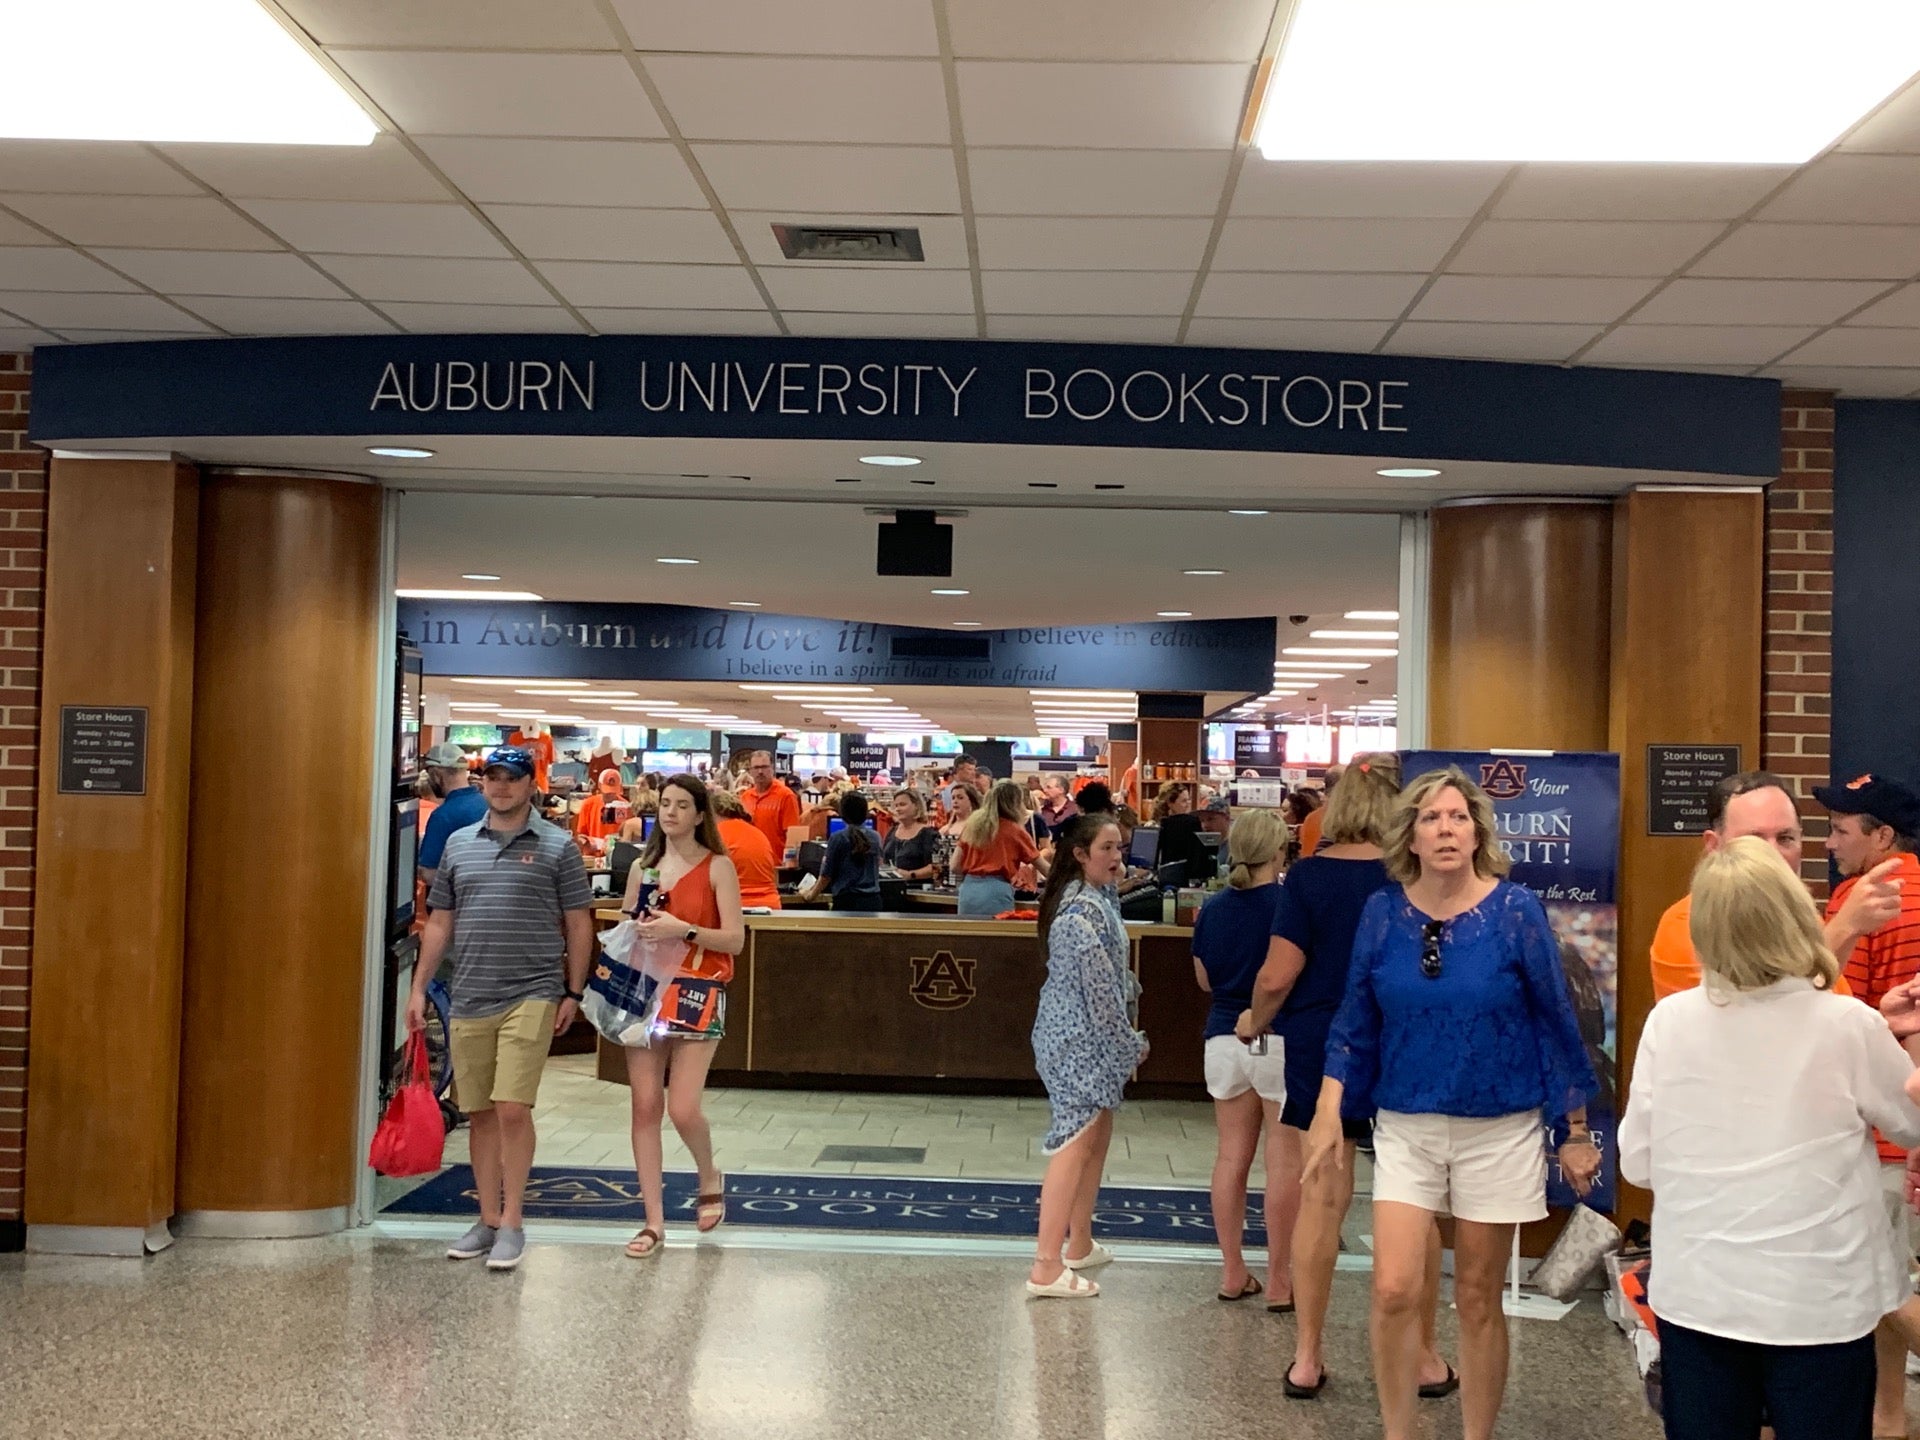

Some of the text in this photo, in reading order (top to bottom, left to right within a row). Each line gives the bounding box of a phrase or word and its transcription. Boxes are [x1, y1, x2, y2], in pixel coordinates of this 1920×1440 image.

[369, 359, 1410, 432] AUBURN UNIVERSITY BOOKSTORE
[420, 610, 460, 645] in
[476, 610, 639, 649] Auburn
[742, 613, 820, 653] love
[838, 617, 880, 655] it!
[1018, 626, 1105, 645] believe
[1113, 625, 1138, 647] in
[725, 657, 1057, 684] I believe in a spirit that is not afraid
[76, 711, 133, 722] Store Hours
[76, 730, 131, 739] Monday Friday
[849, 746, 884, 755] SAMFORD
[1662, 751, 1725, 761] Store Hours
[849, 761, 884, 769] DONAHUE
[1664, 769, 1723, 777] Monday Friday
[1528, 777, 1570, 797] Your
[1661, 798, 1693, 806] Saturday
[1680, 807, 1708, 815] CLOSED
[1546, 883, 1565, 899] the
